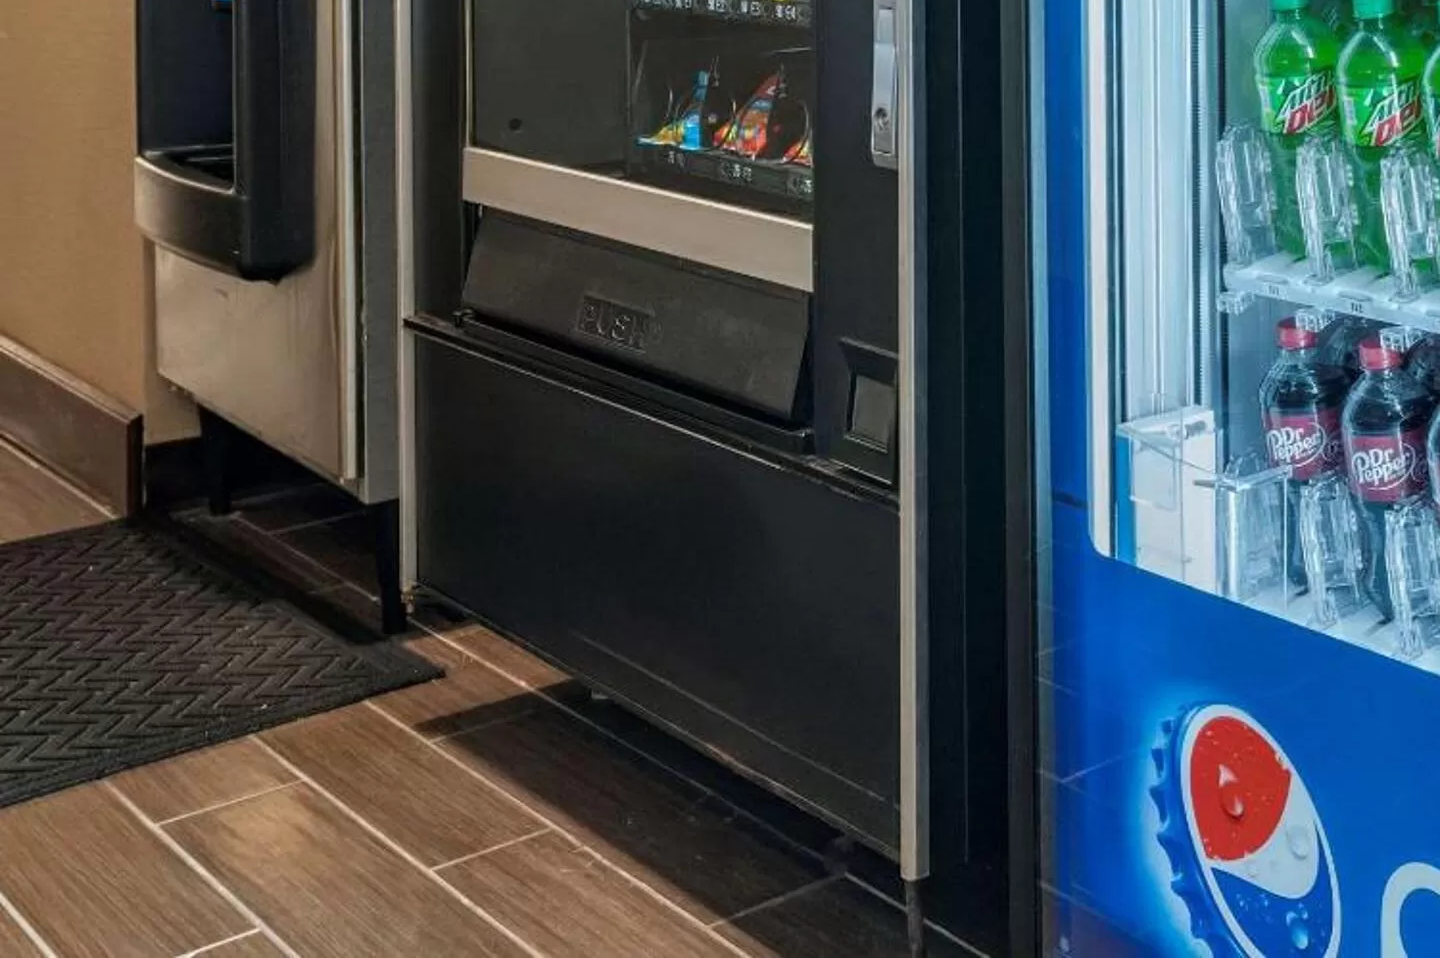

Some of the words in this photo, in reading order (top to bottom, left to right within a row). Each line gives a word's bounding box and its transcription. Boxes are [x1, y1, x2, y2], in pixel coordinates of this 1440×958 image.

[1268, 430, 1321, 461] Pepper
[1282, 428, 1304, 444] Dr
[1368, 448, 1394, 463] Dr
[1354, 452, 1410, 485] Pepper
